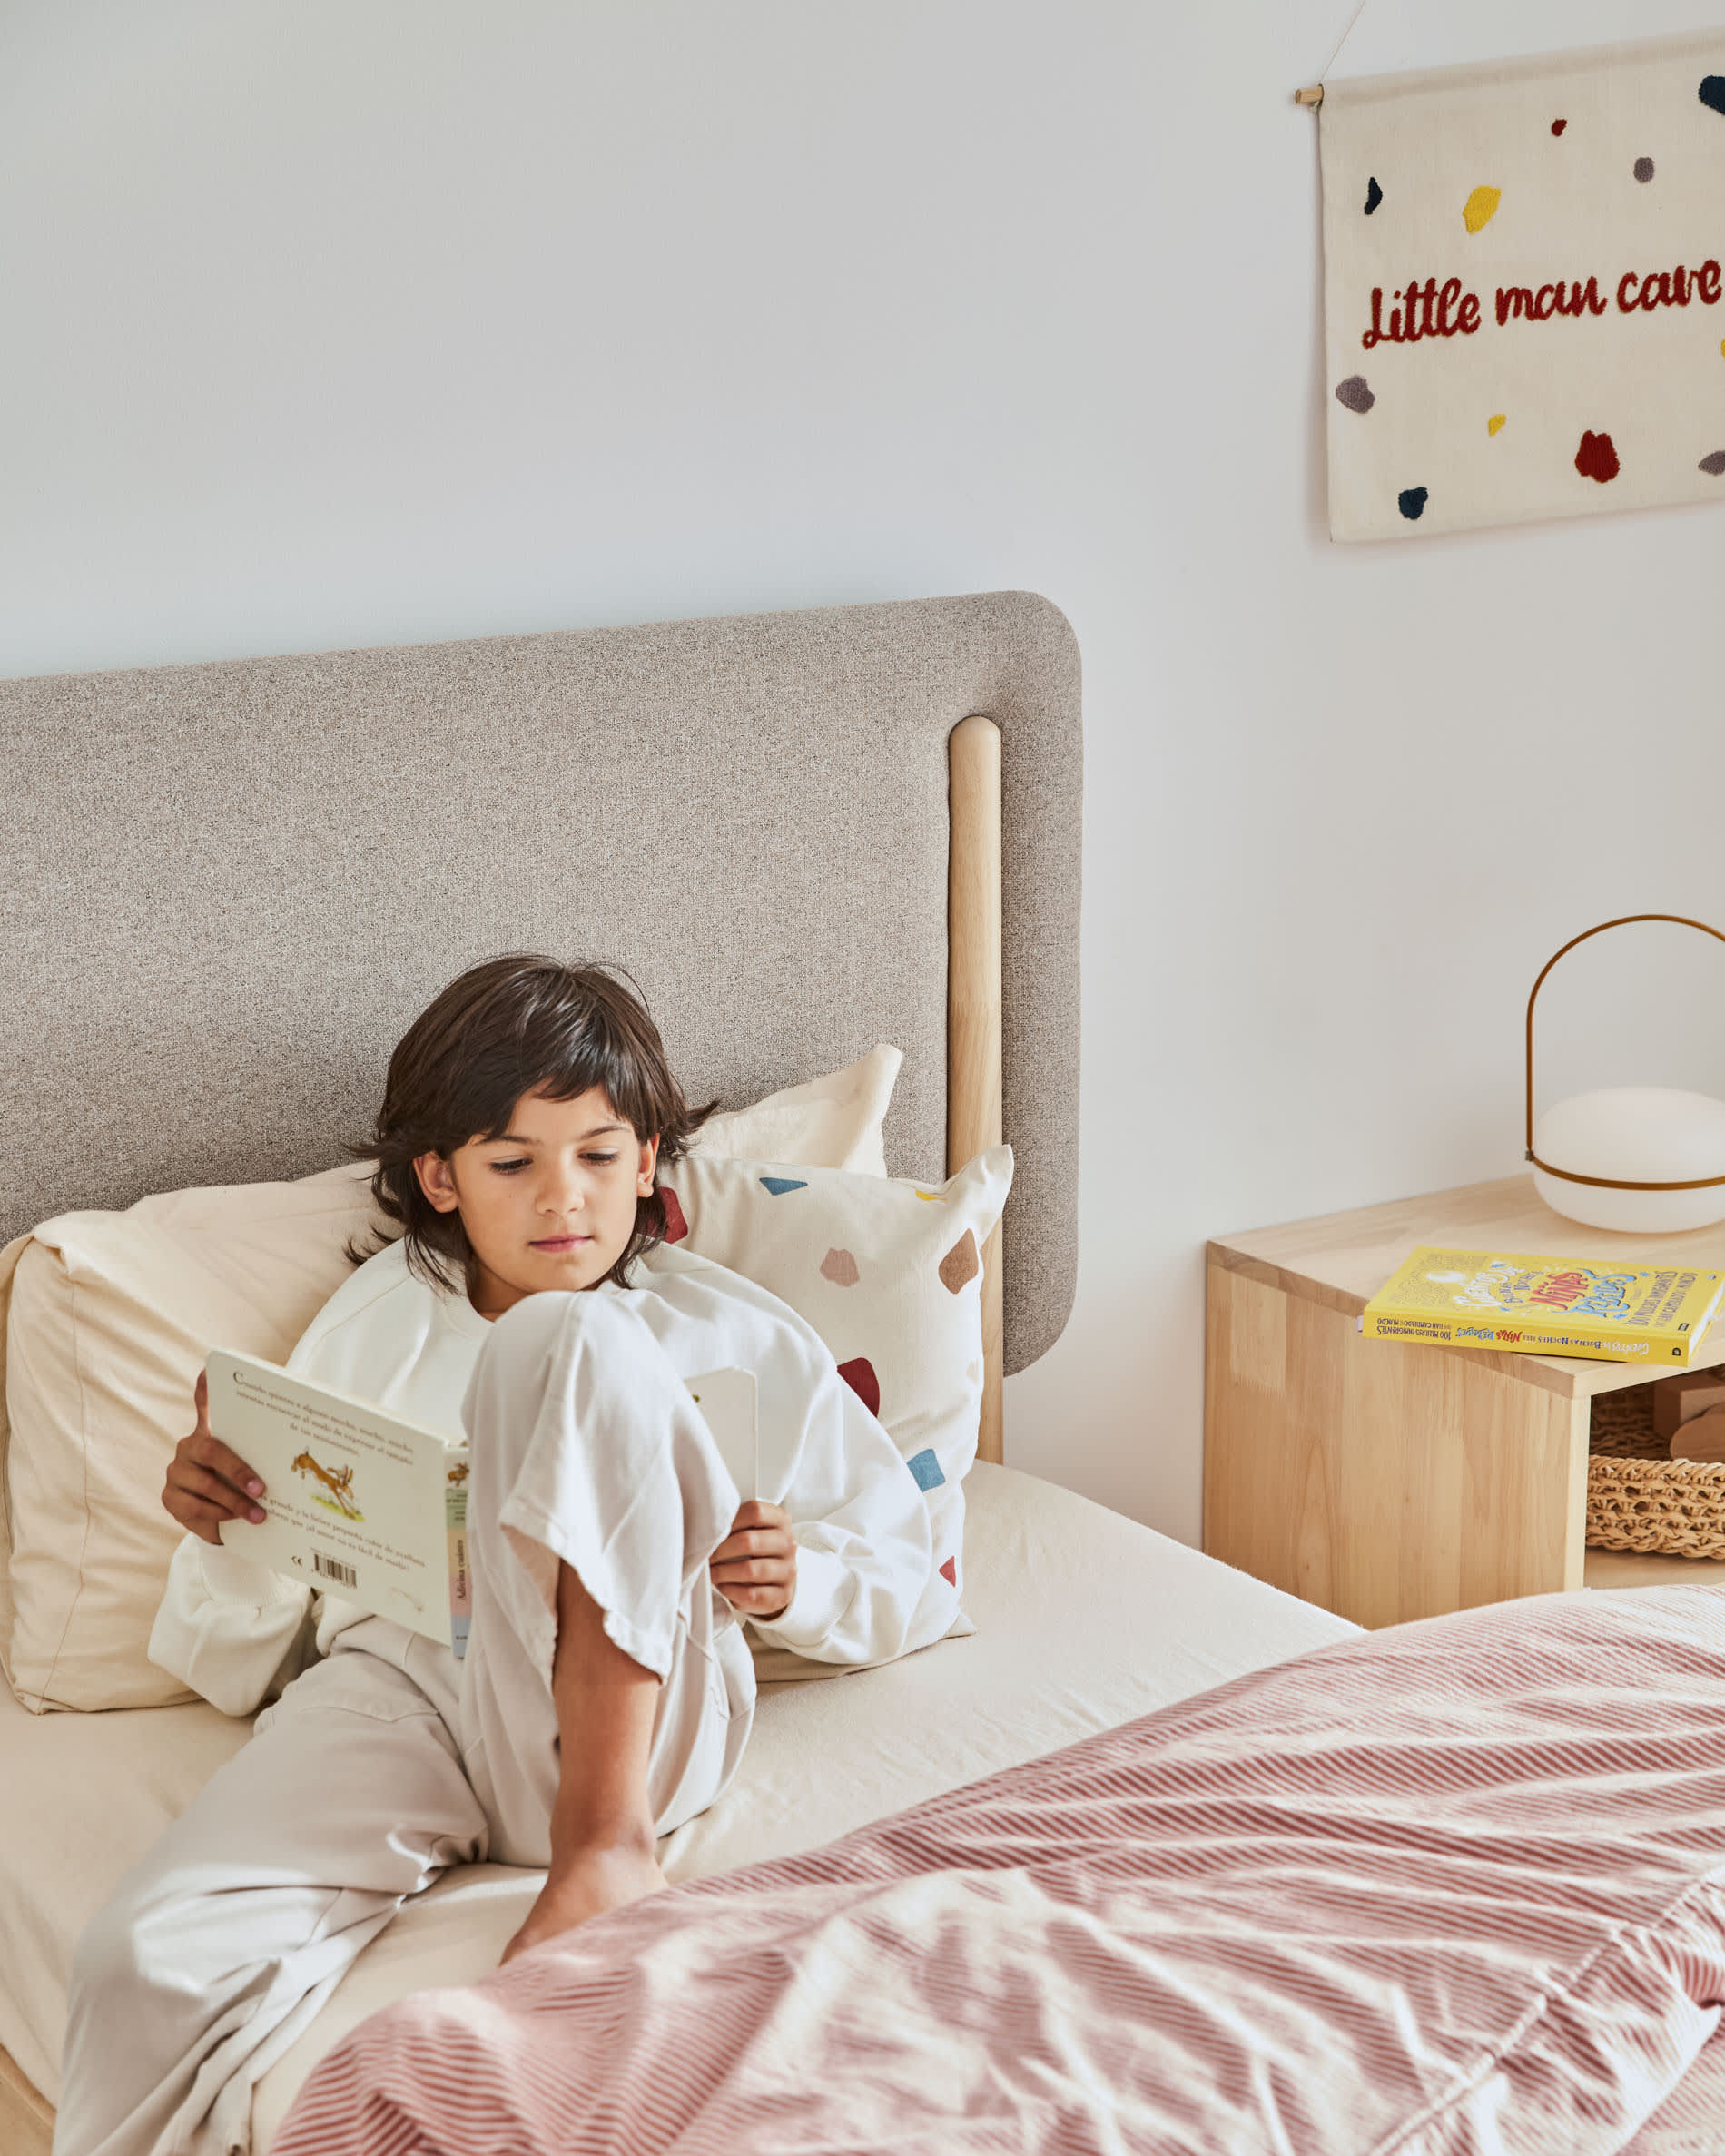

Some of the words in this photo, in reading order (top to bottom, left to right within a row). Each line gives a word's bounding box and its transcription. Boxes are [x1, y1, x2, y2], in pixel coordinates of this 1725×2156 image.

[1362, 277, 1482, 349] Little
[1495, 276, 1608, 326] man
[1617, 259, 1722, 313] cave
